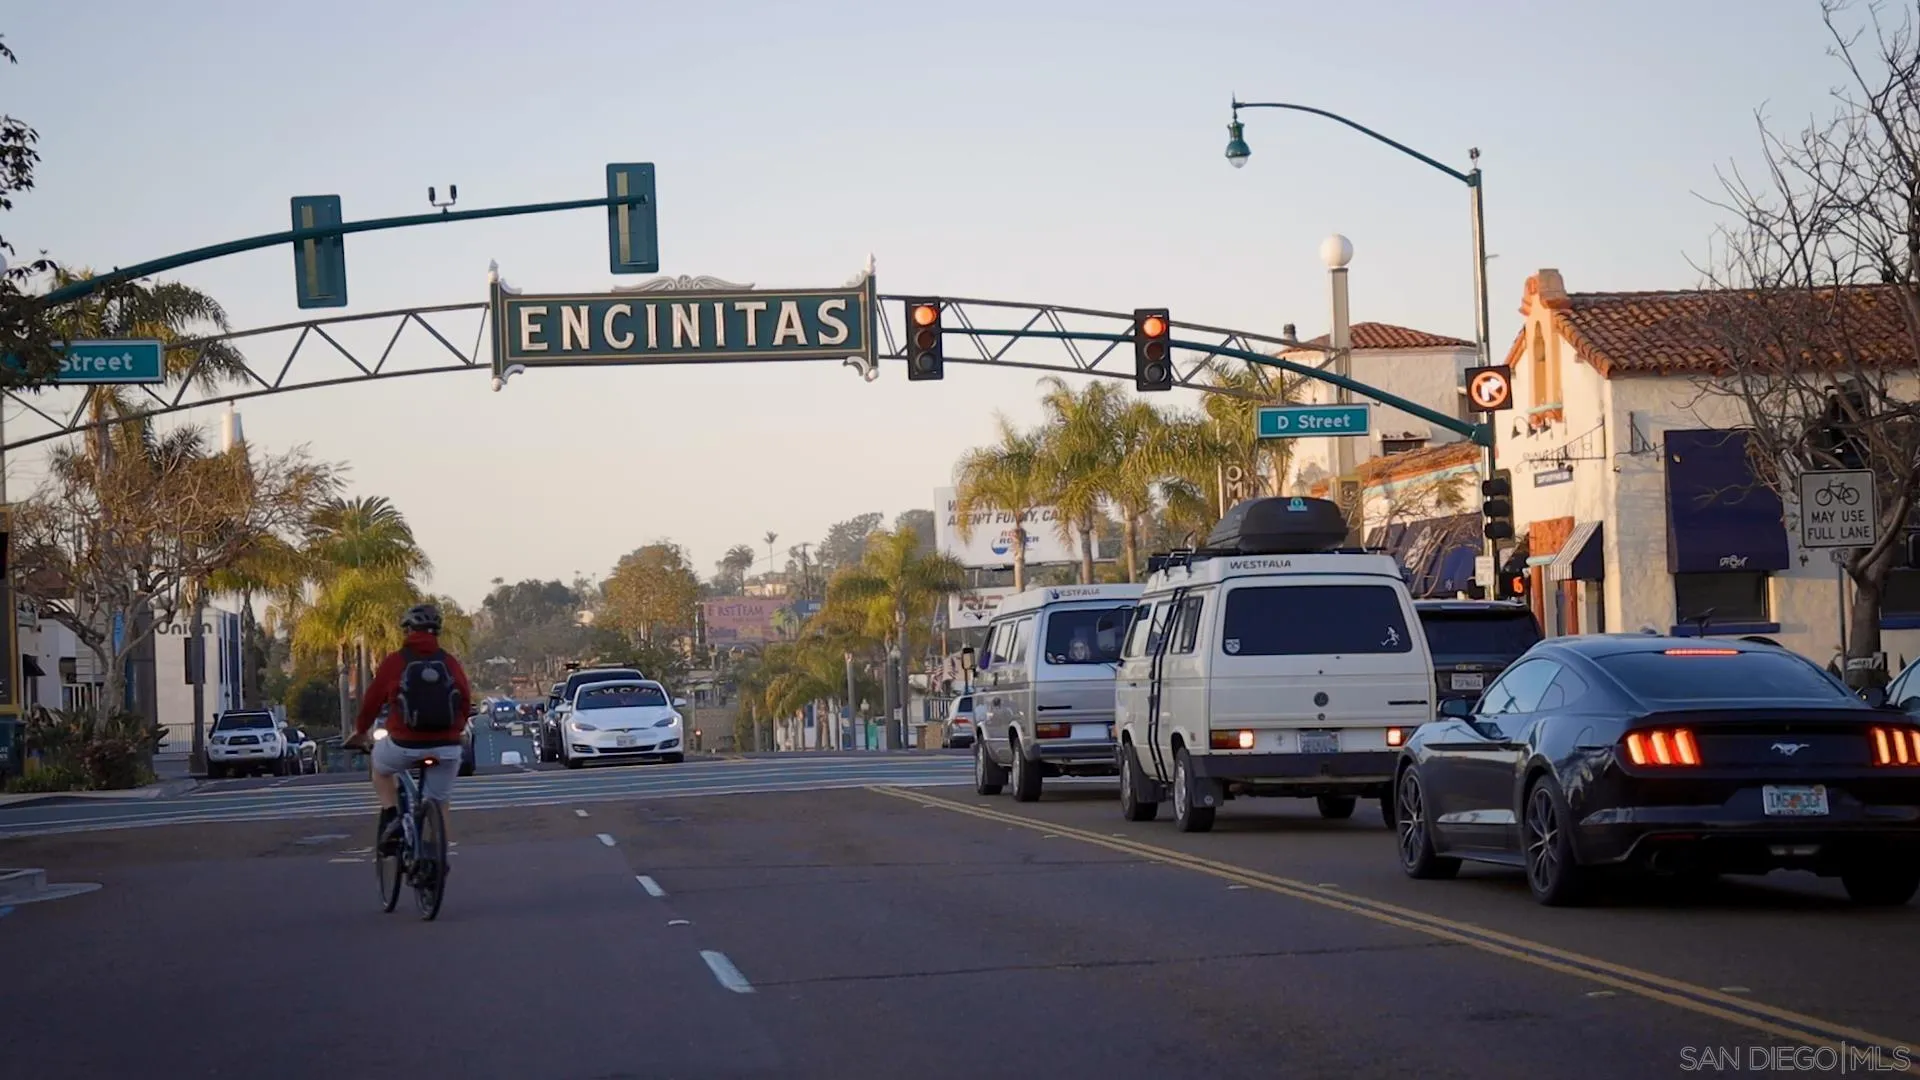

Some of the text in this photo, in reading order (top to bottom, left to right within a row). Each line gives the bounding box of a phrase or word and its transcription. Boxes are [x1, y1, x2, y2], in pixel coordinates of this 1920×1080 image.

[519, 298, 848, 351] ENCINITAS
[1277, 413, 1351, 430] D Street
[1811, 509, 1866, 523] MAY USE
[1808, 525, 1871, 540] FULL LANE
[1230, 559, 1292, 569] WESTFALIA
[157, 620, 213, 635] Unin
